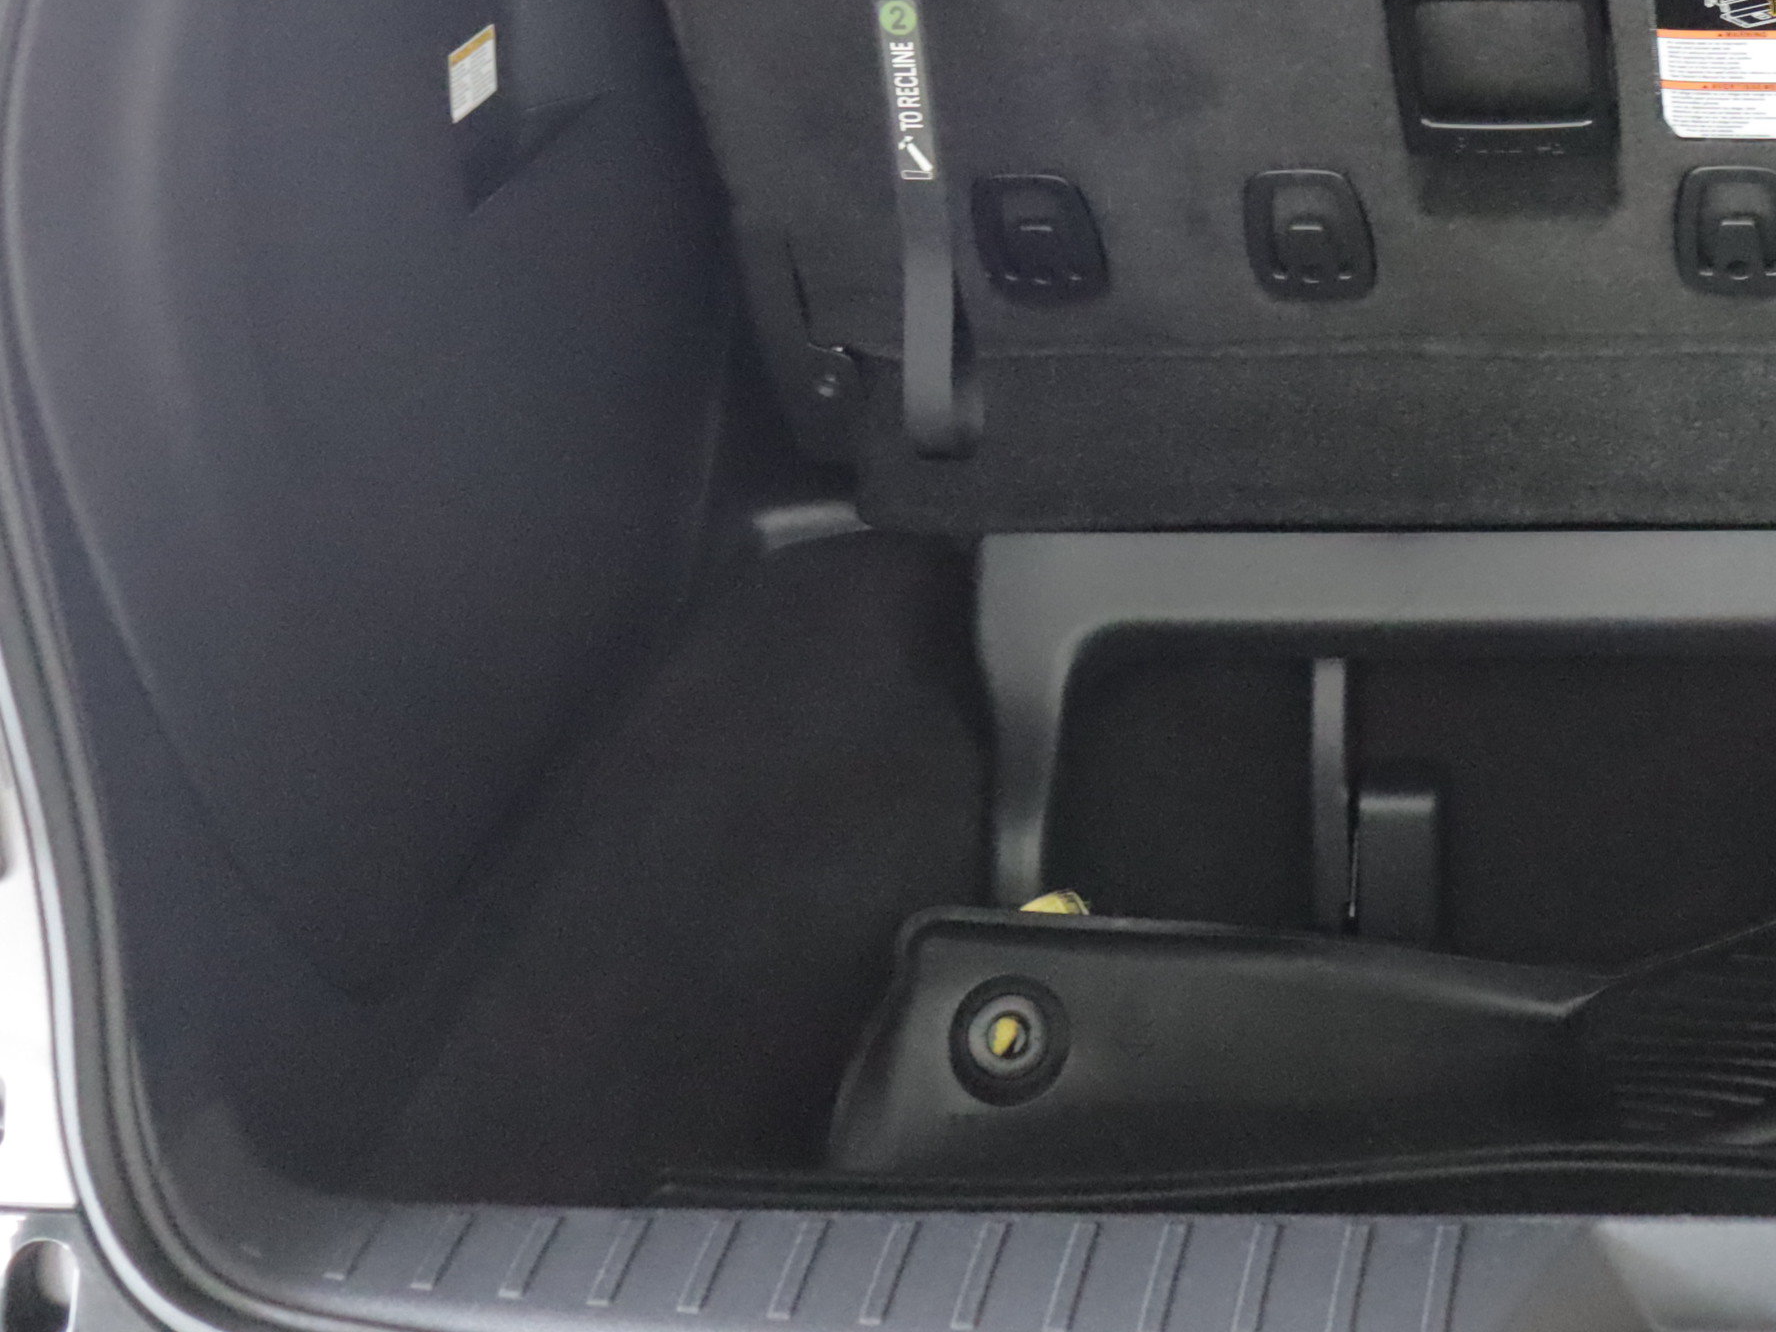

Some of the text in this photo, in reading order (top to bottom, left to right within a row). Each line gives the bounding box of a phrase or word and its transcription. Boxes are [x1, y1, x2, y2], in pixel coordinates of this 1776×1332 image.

[889, 5, 907, 30] 2
[889, 41, 924, 131] TO RECLINE
